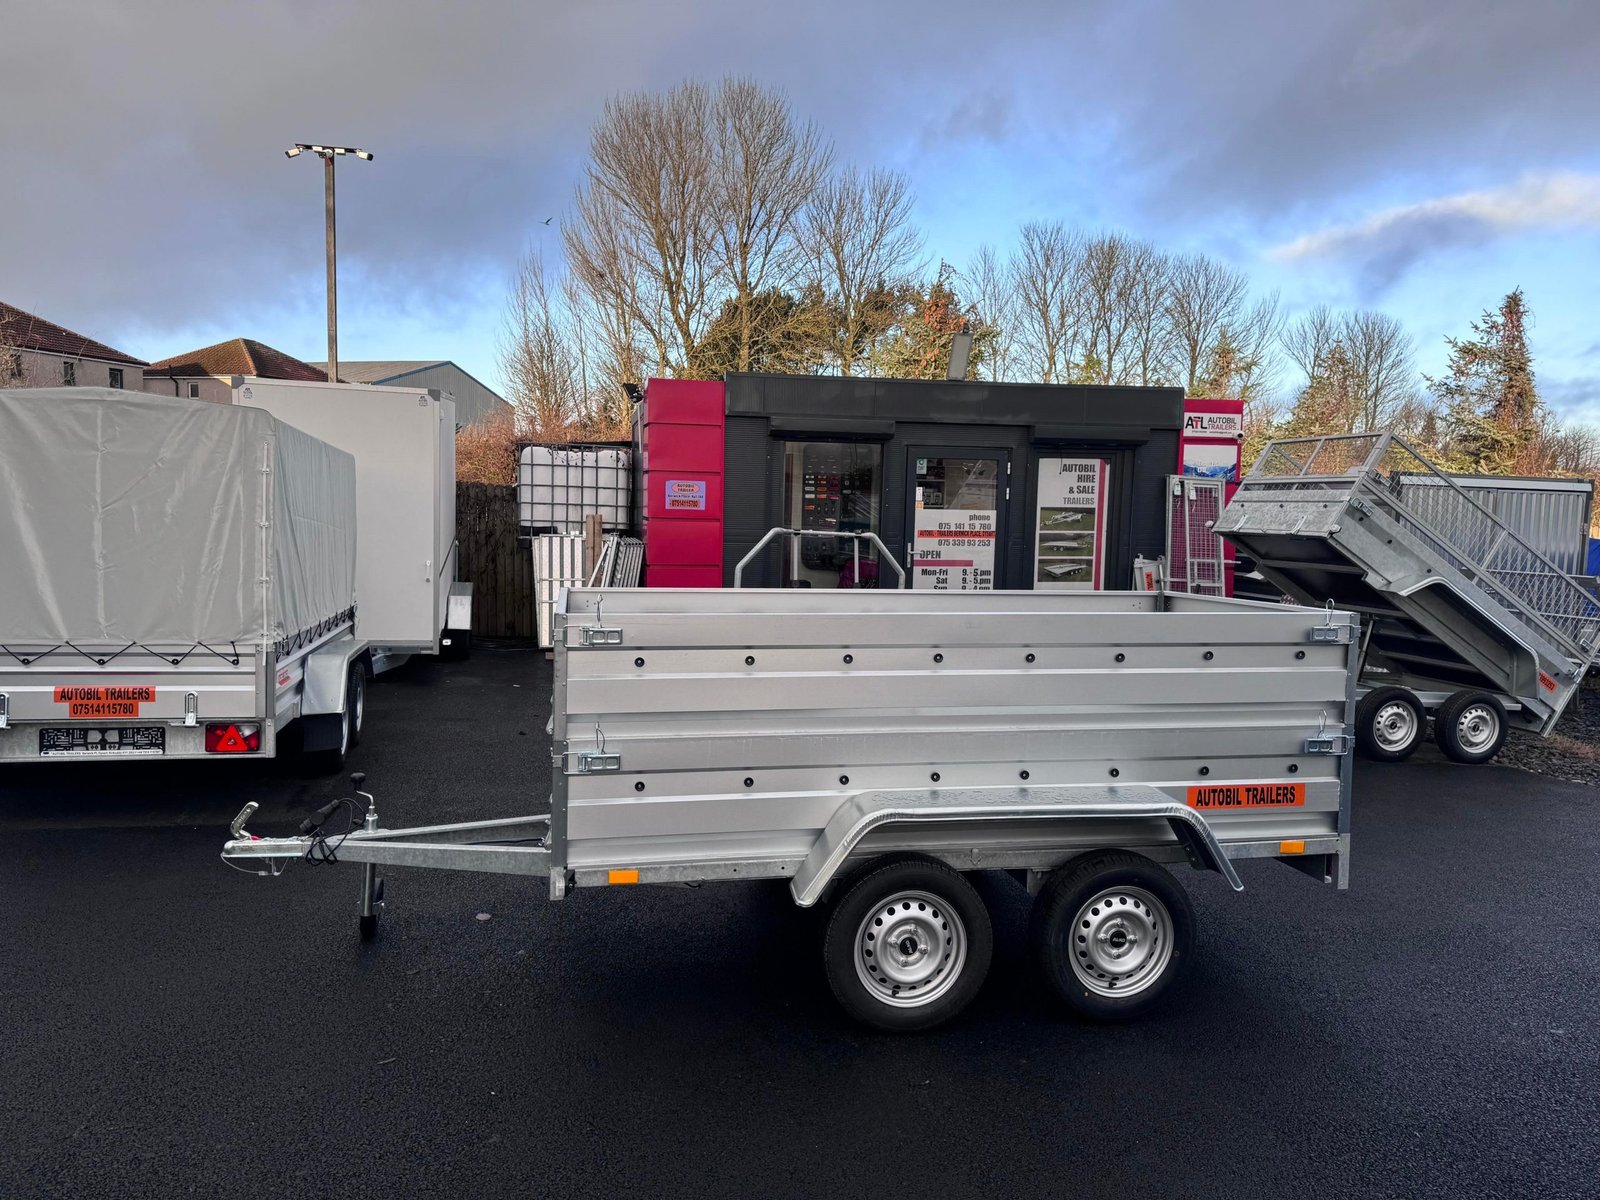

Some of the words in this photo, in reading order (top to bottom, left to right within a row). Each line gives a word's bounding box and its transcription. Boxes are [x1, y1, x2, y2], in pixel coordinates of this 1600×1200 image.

[1185, 416, 1207, 429] ATL
[1062, 464, 1096, 472] AUTOBIL
[1077, 474, 1096, 483] HIRE
[1069, 486, 1075, 494] &
[1076, 485, 1095, 494] SALE
[1063, 497, 1095, 505] TRAILERS
[920, 550, 941, 559] OPEN
[60, 688, 101, 700] AUTOBIL
[105, 688, 150, 700] TRAILERS
[72, 703, 134, 715] 07514115780
[1196, 788, 1242, 806] AUTOBIL
[1245, 786, 1296, 805] TRAILERS
